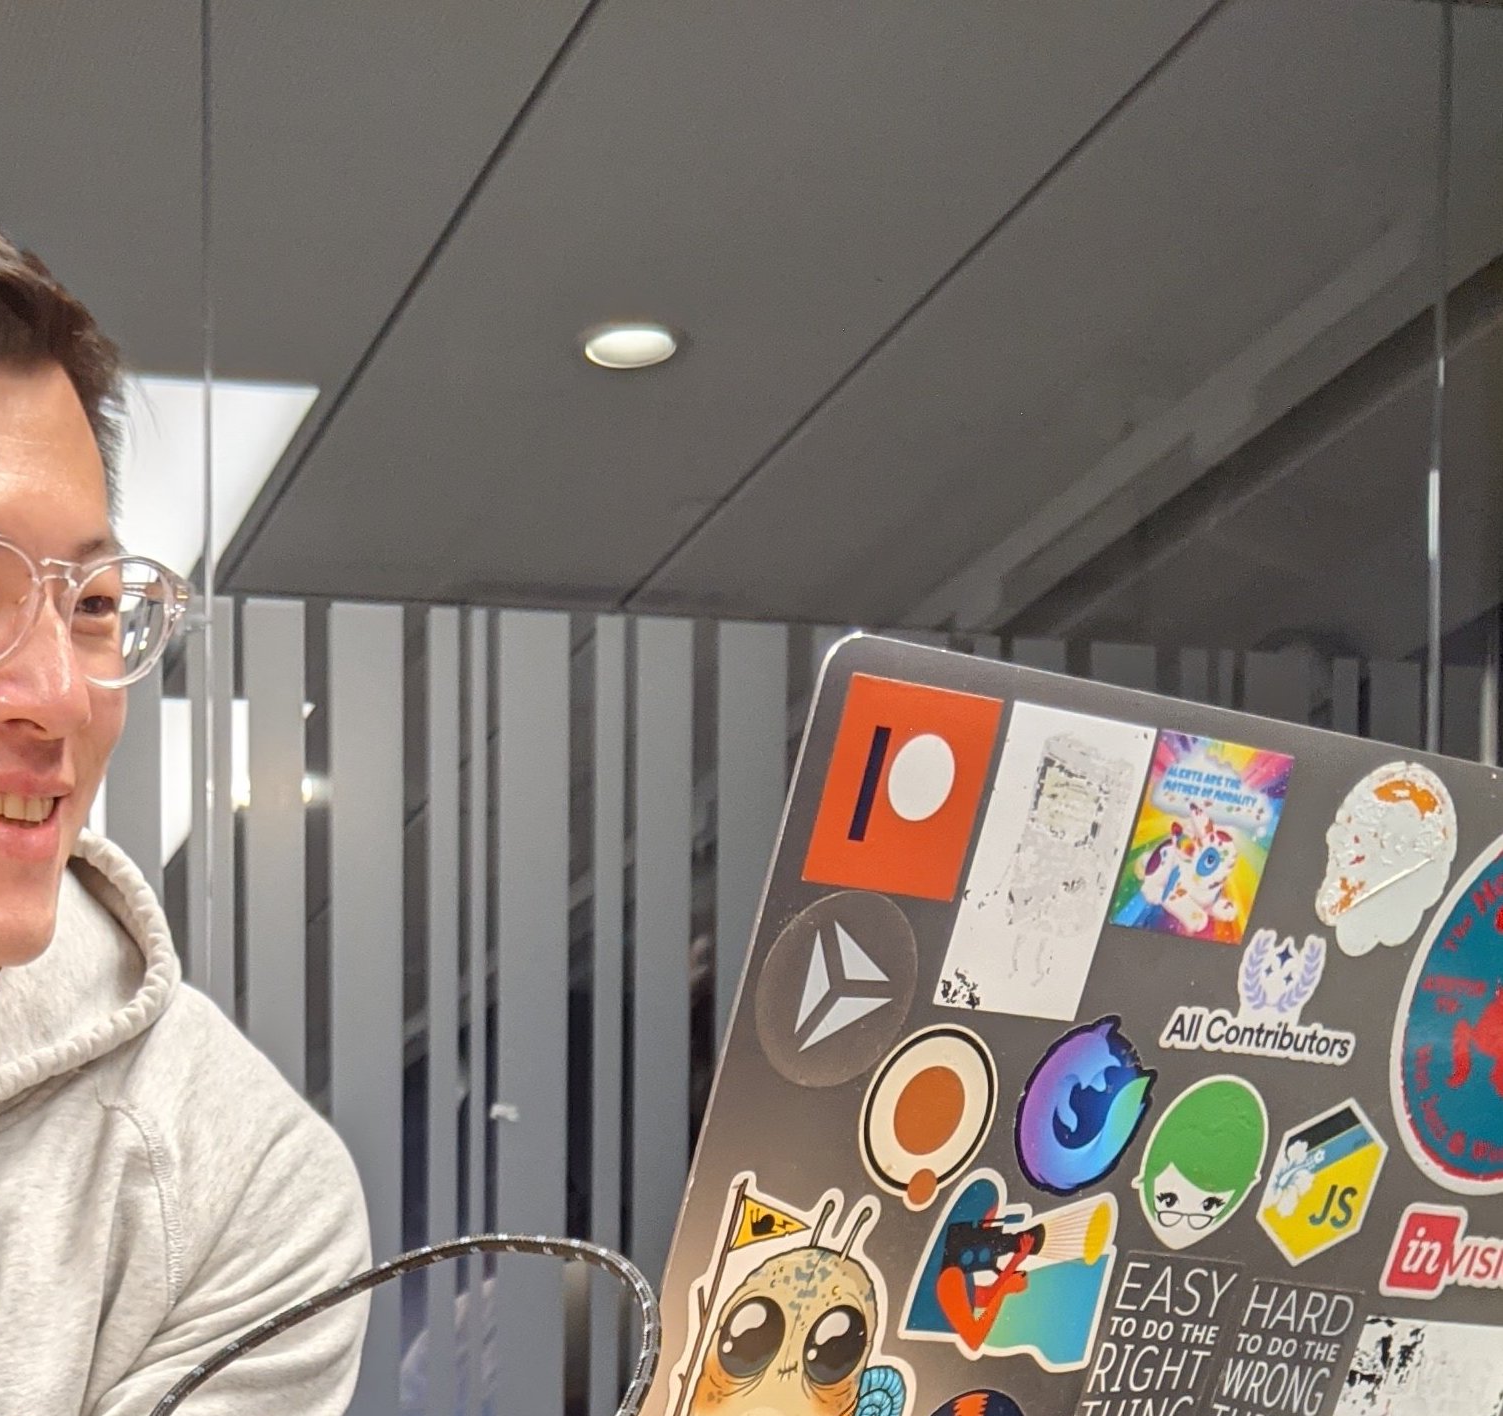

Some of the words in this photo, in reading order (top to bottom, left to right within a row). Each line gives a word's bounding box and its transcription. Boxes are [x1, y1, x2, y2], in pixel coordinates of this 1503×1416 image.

[1167, 766, 1203, 782] ALERTS
[1203, 773, 1223, 787] ARE
[1165, 1013, 1203, 1043] All
[1205, 1015, 1351, 1059] Contributors
[1308, 1184, 1358, 1229] JS
[1114, 1261, 1239, 1319] EASY
[1241, 1284, 1355, 1337] HARD
[1109, 1316, 1137, 1338] TO
[1141, 1319, 1174, 1341] DO
[1180, 1323, 1220, 1345] THE
[1236, 1333, 1263, 1354] TO
[1266, 1336, 1298, 1358] DO
[1303, 1340, 1341, 1363] THE
[1086, 1341, 1212, 1394] RIGHT
